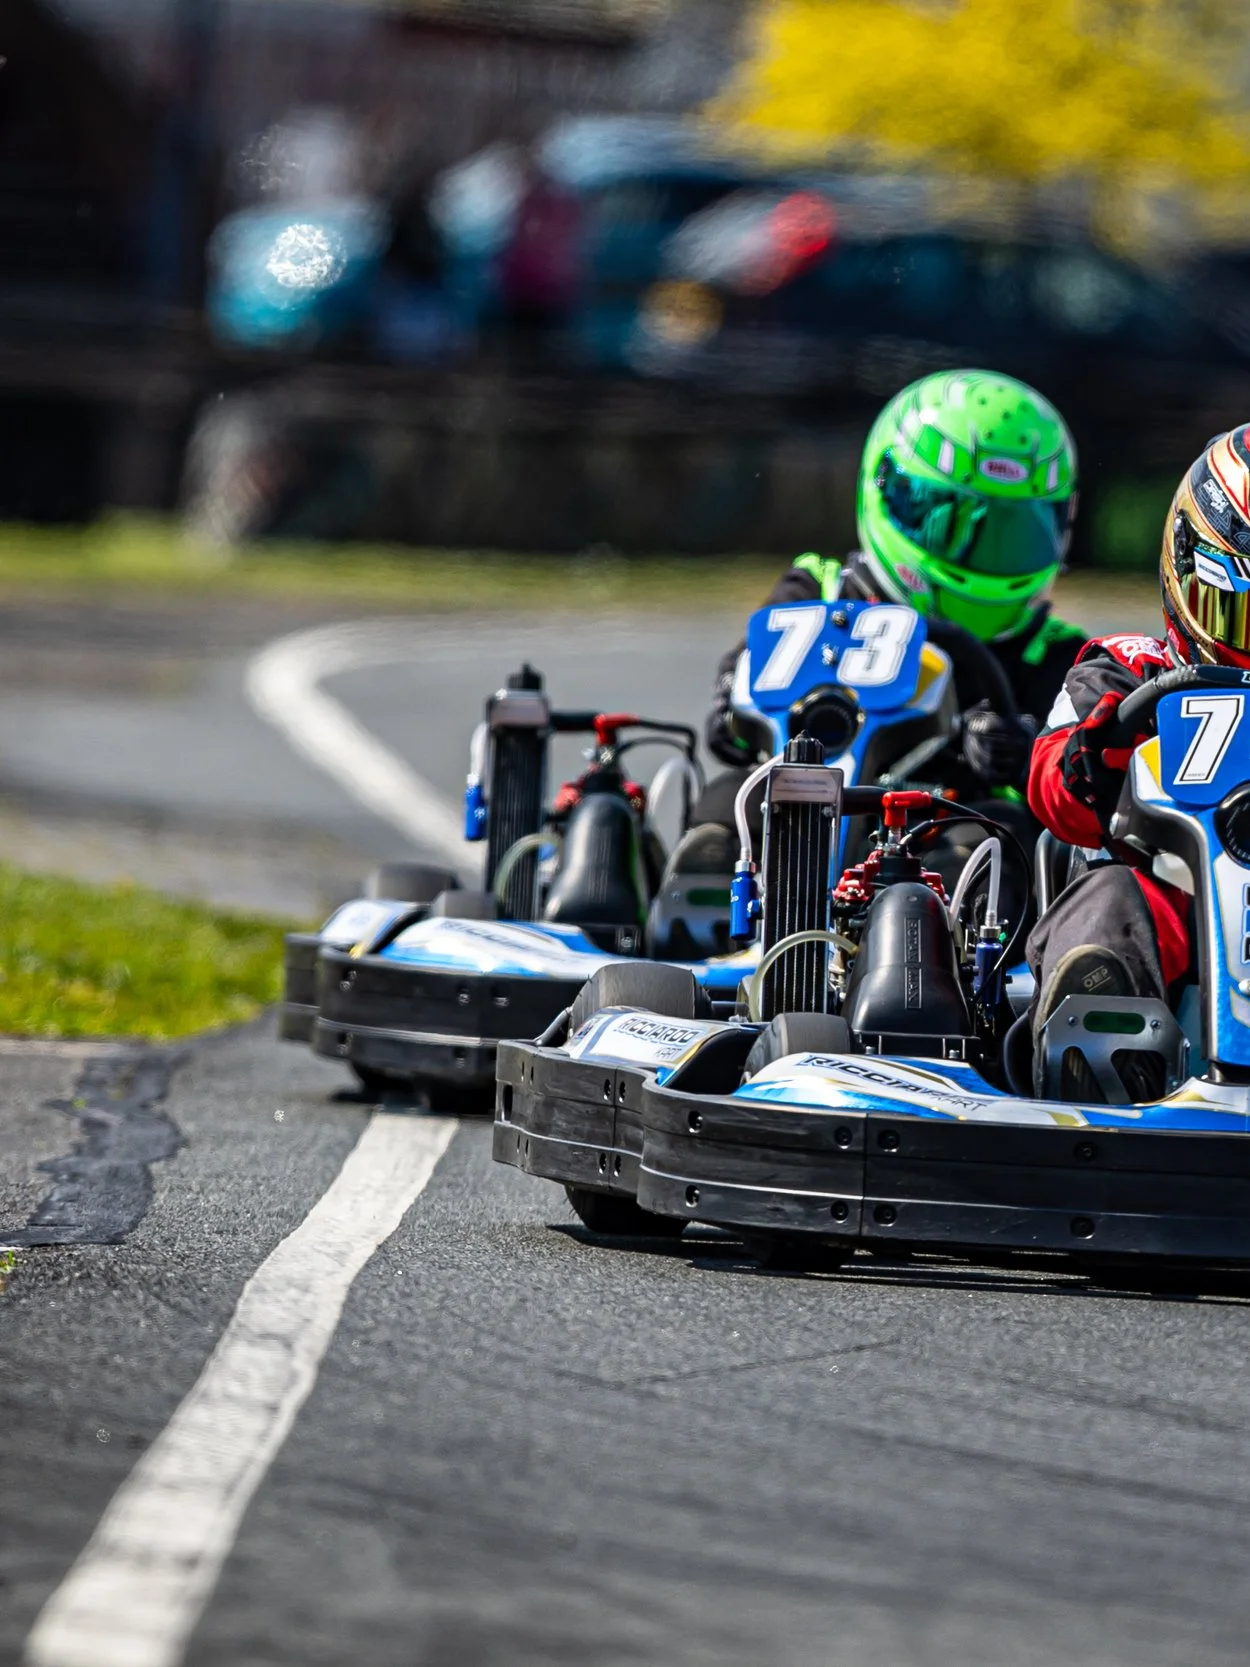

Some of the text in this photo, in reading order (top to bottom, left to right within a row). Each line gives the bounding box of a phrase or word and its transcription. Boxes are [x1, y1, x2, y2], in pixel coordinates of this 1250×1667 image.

[753, 605, 918, 693] 73
[1083, 967, 1109, 989] OMP
[619, 1018, 701, 1043] RICCIARDO
